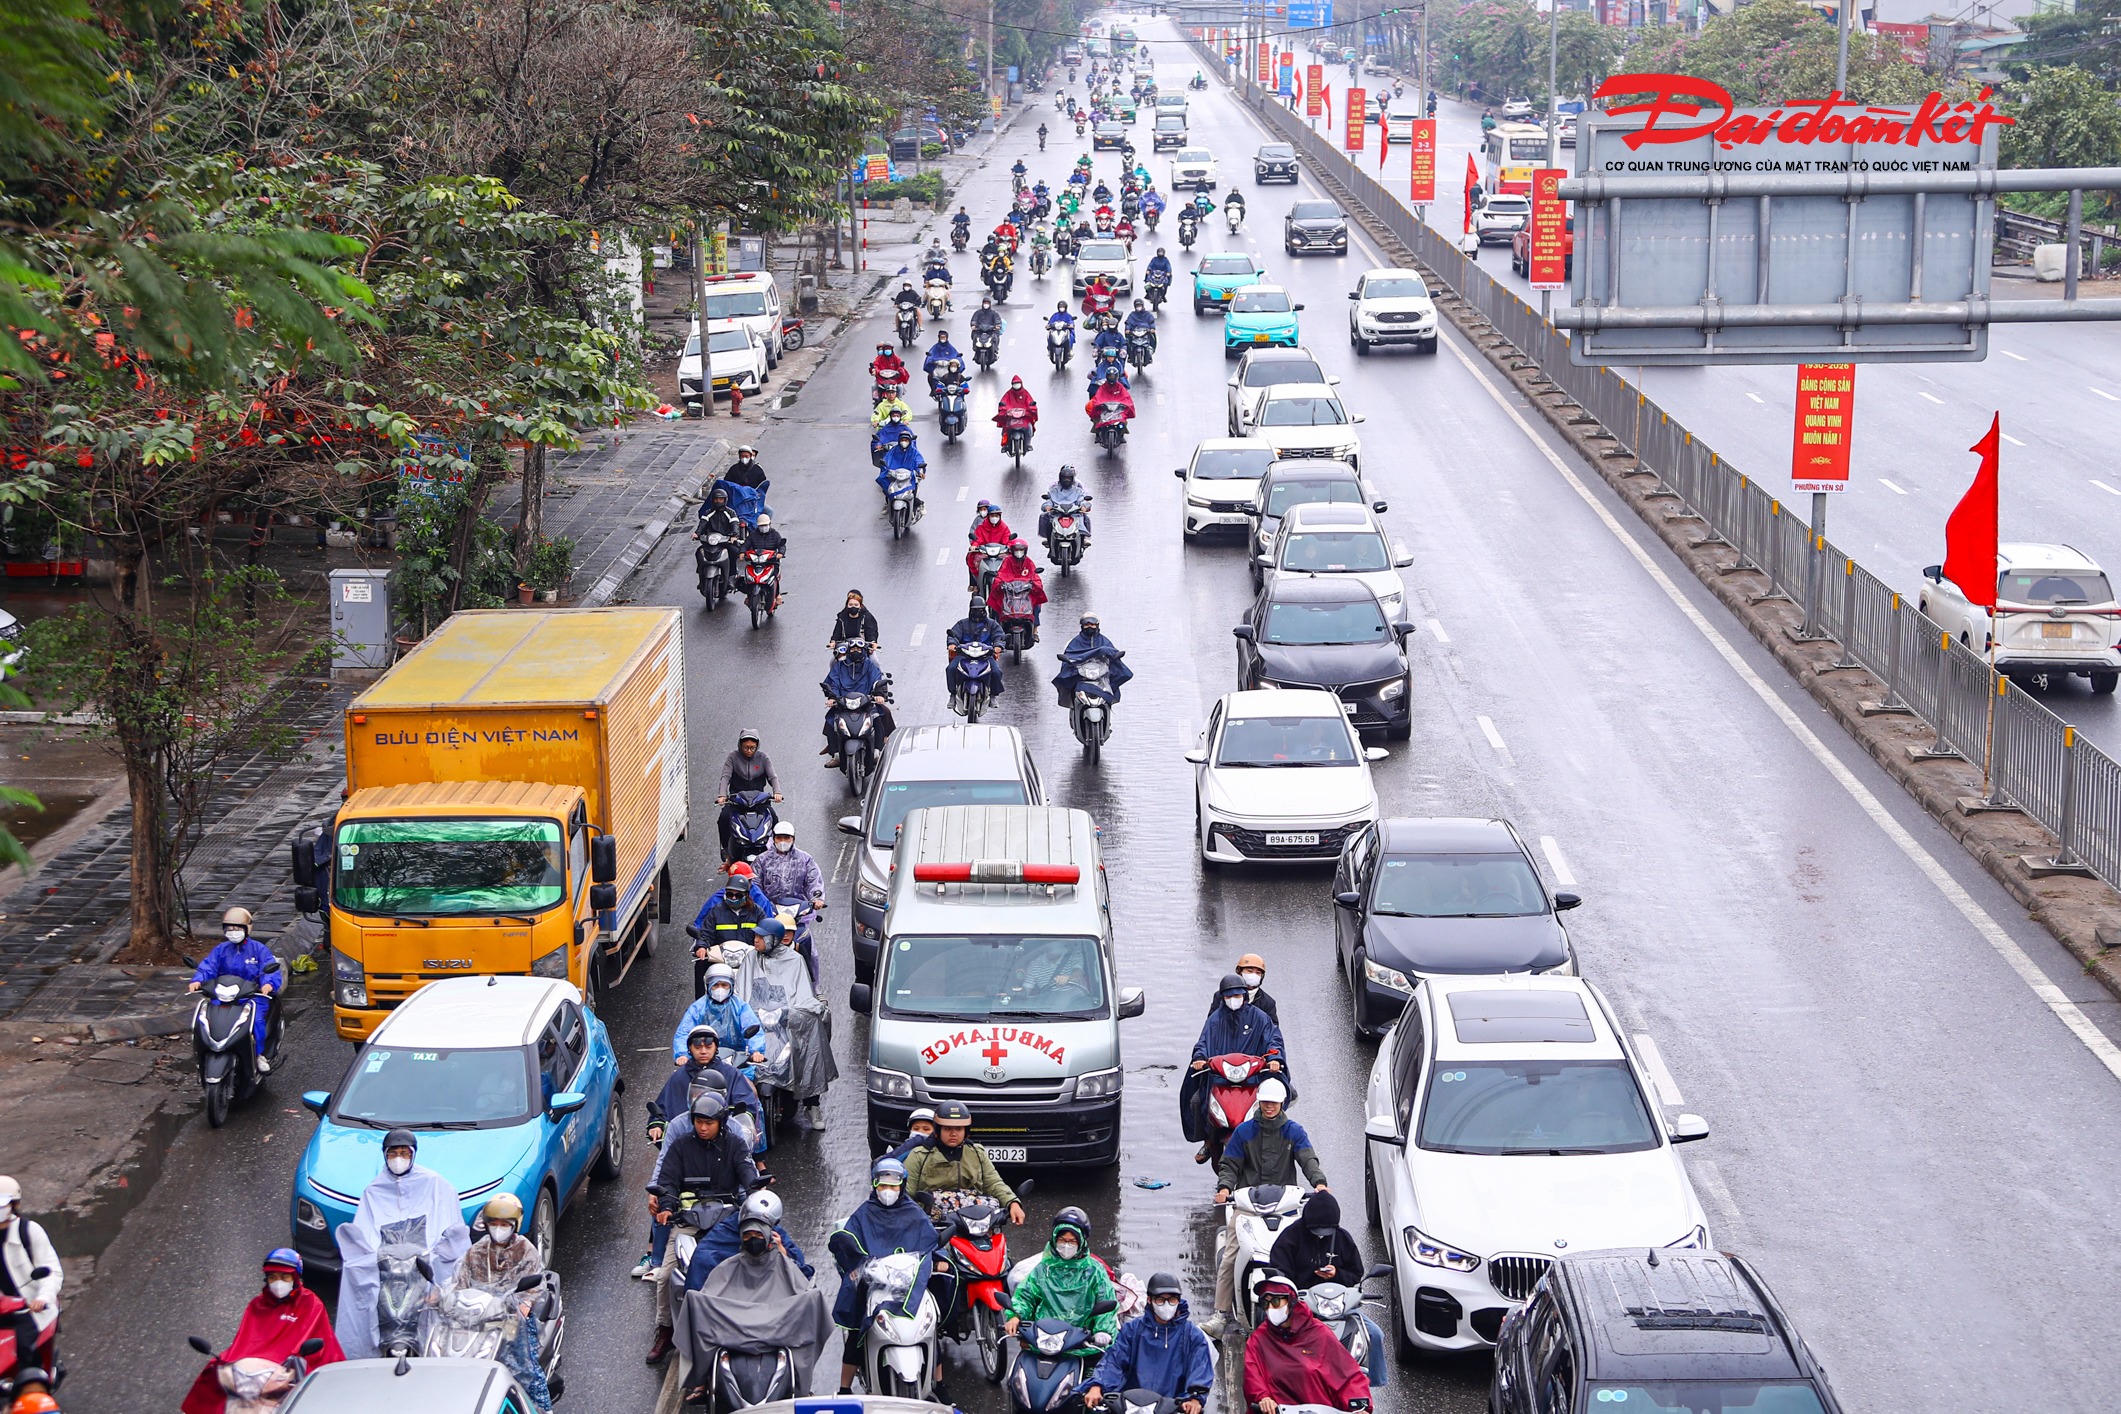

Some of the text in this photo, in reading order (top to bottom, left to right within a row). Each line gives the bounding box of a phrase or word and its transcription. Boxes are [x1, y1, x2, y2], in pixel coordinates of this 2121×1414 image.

[1800, 376, 1851, 394] ĐẢNG CỘNG SẢN
[1810, 395, 1840, 412] VIỆT NAM
[1805, 415, 1842, 428] QUANG VINH
[1802, 430, 1822, 445] MUÔN
[1823, 430, 1838, 445] NĂM
[1794, 483, 1844, 492] PHƯỜNG YÊN SỞ
[375, 726, 579, 750] BƯU ĐIỆN VIỆT NAM
[423, 959, 473, 969] ISUZU
[413, 1052, 438, 1061] TAXI
